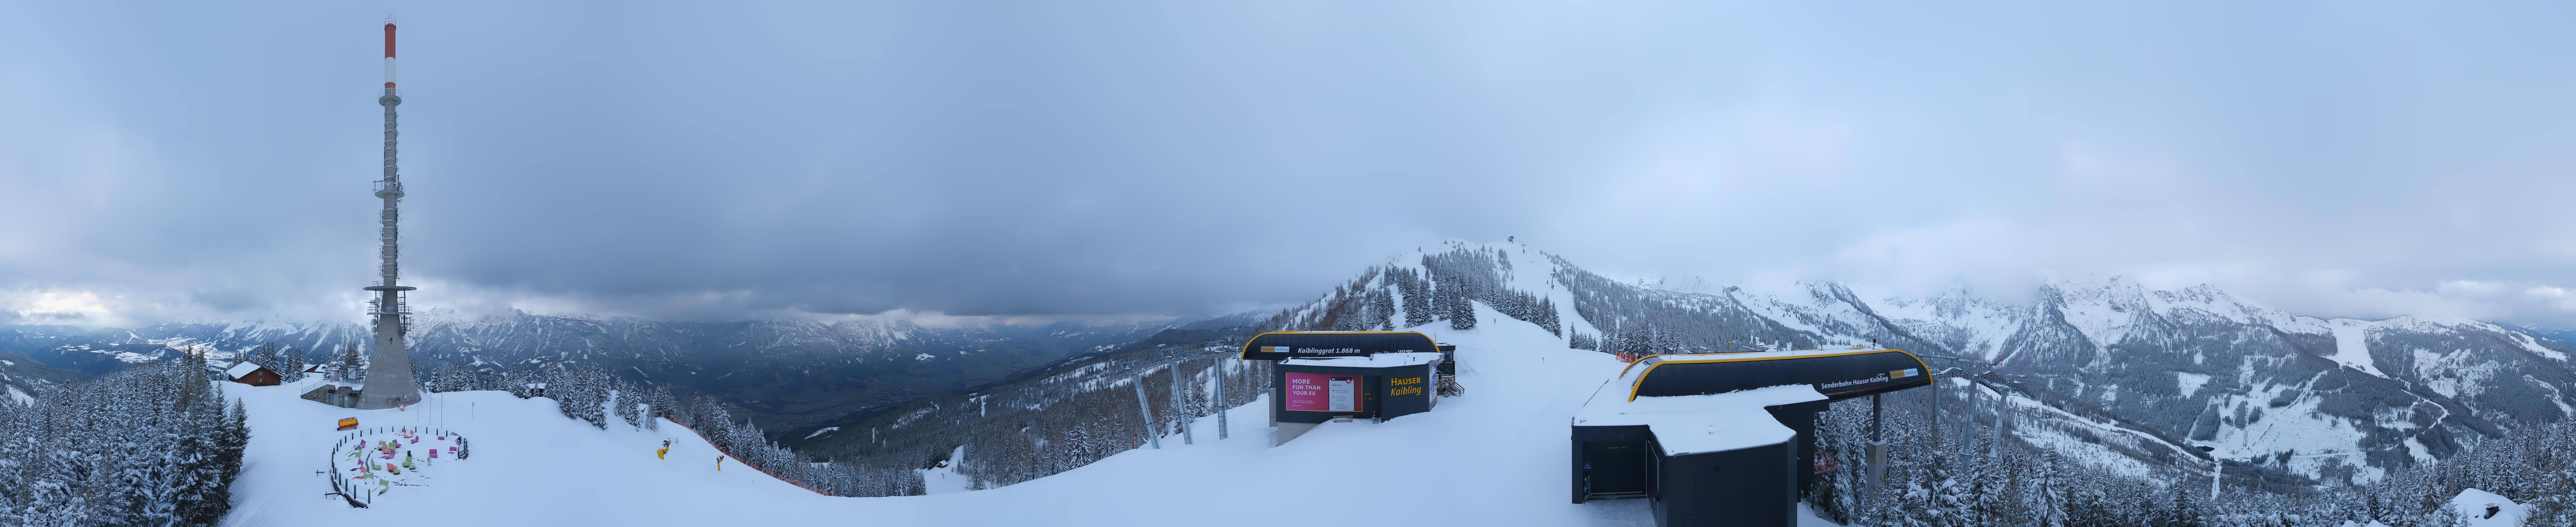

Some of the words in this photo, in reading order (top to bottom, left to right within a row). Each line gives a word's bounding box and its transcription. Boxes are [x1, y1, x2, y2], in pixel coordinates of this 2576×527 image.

[1391, 377, 1421, 386] HAUSER
[1821, 380, 1852, 389] Senderbahn
[1391, 386, 1421, 396] Kaibling
